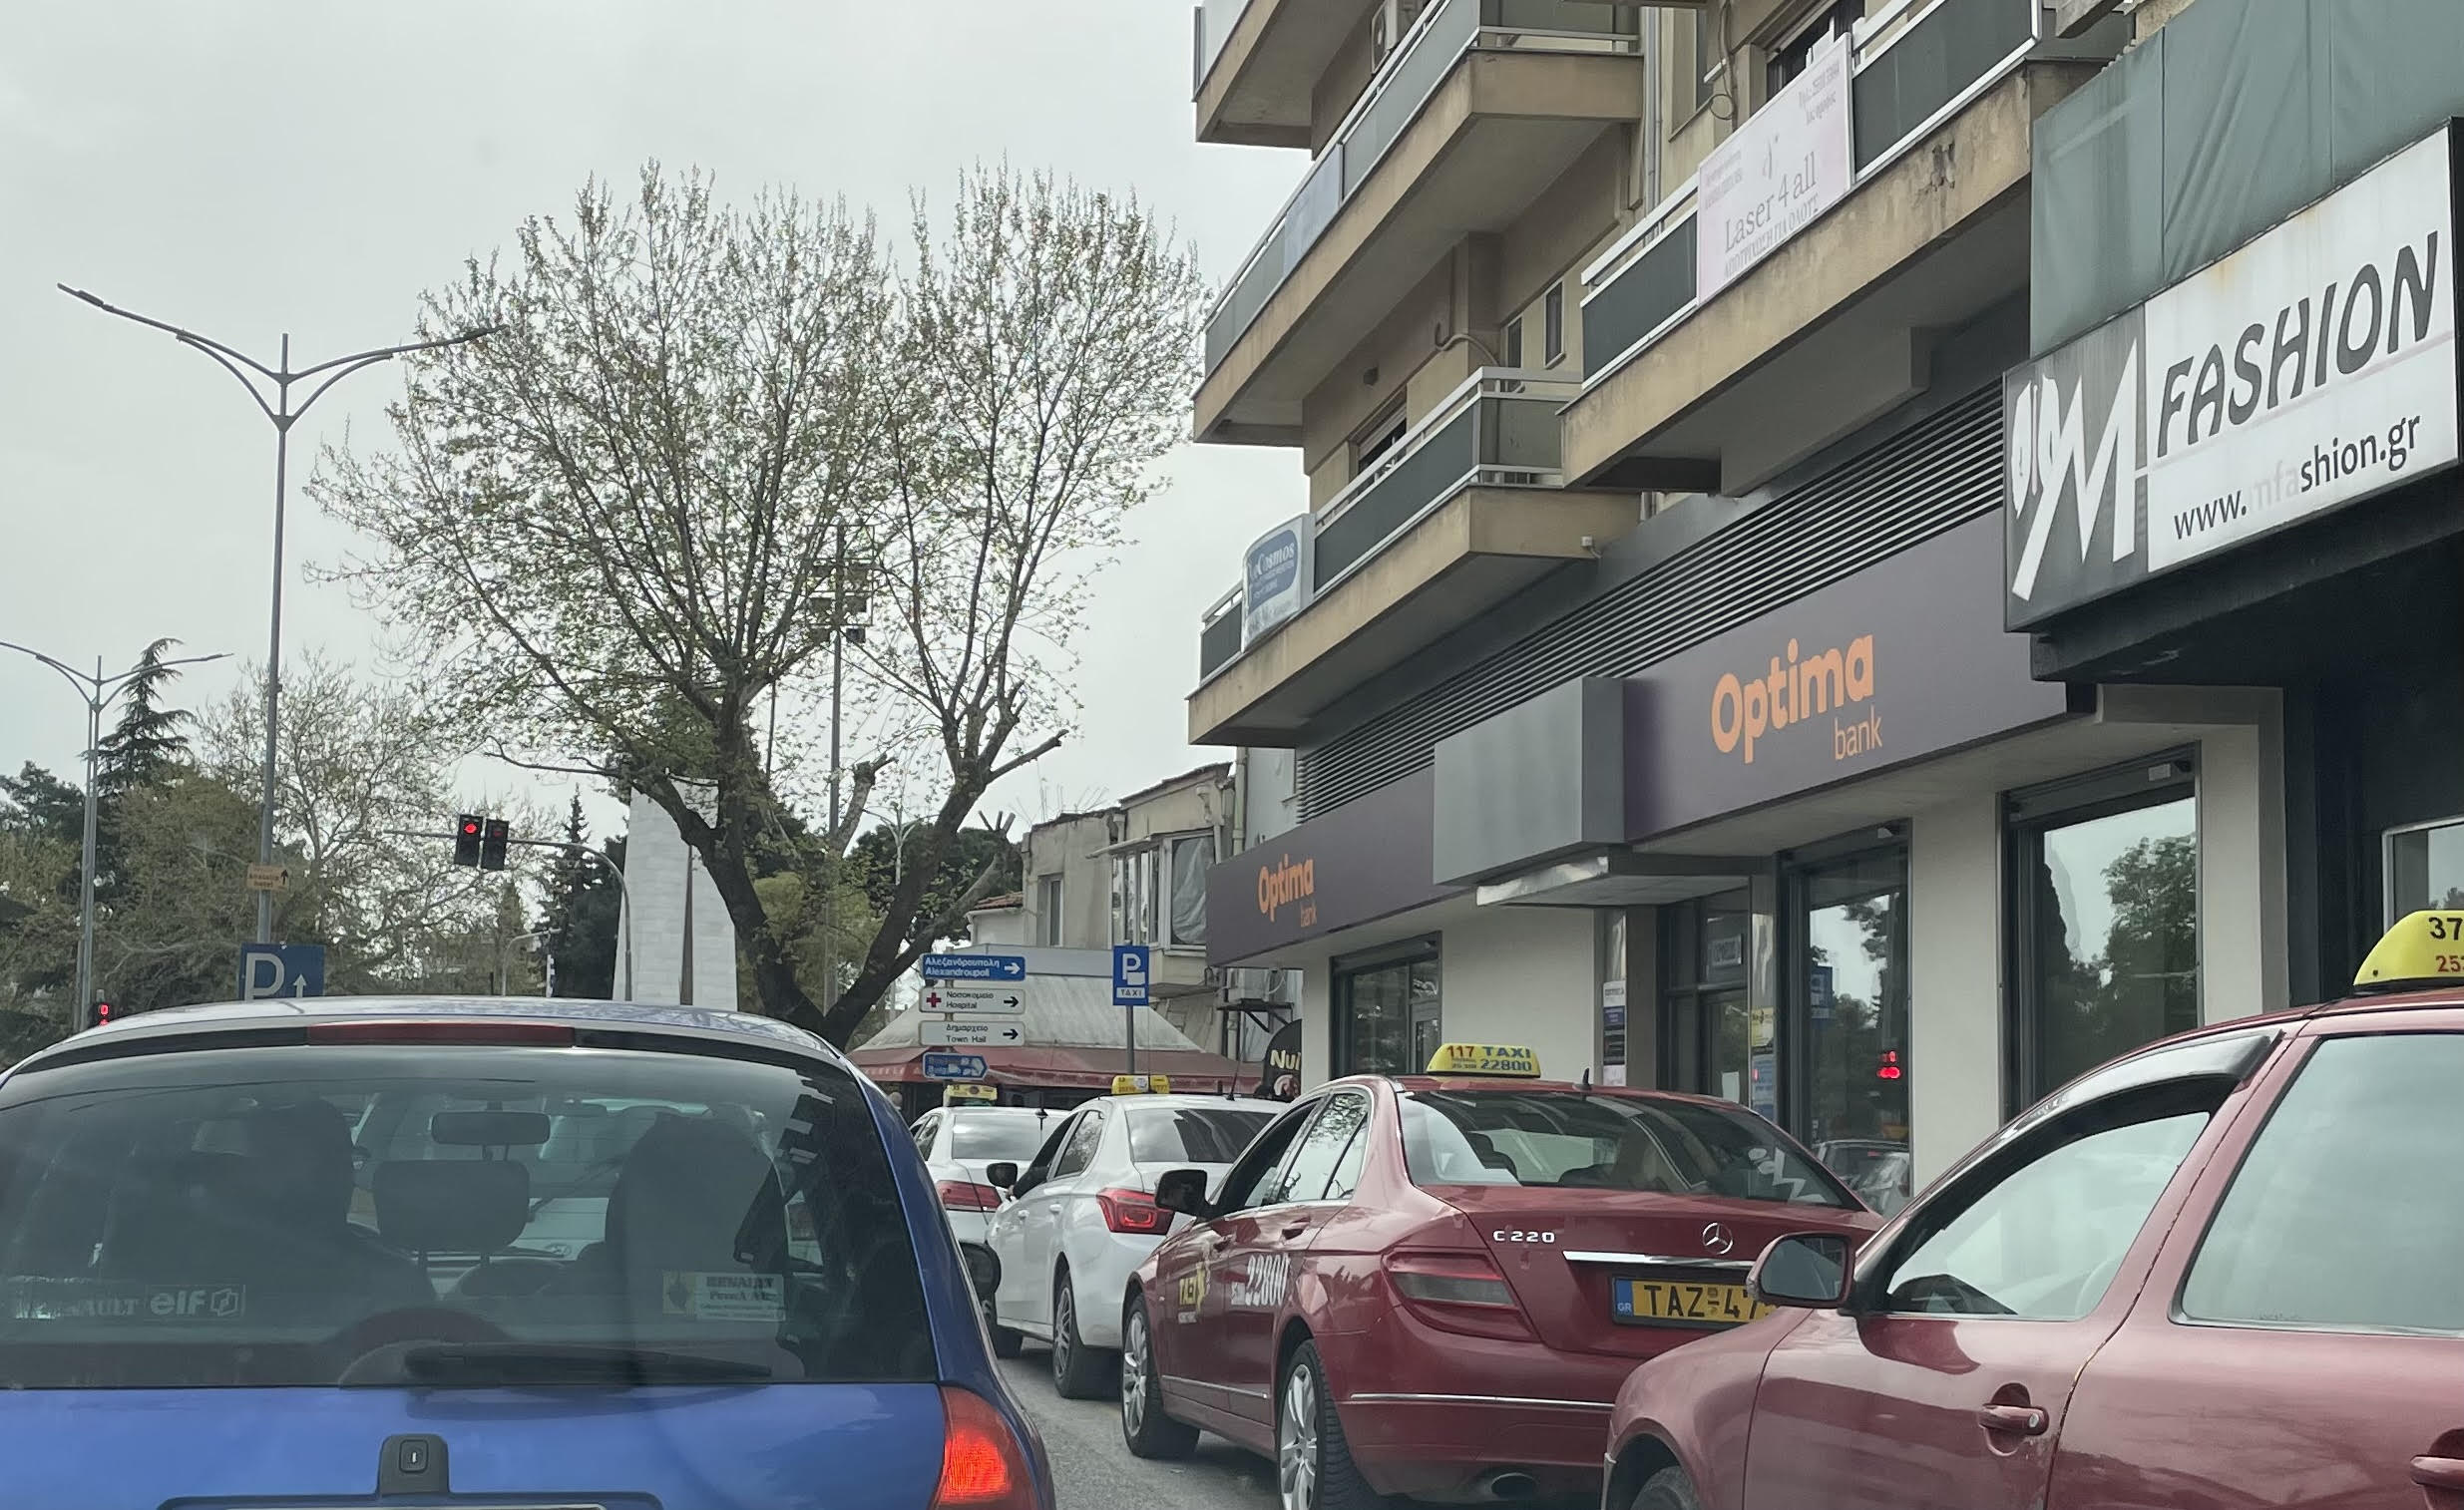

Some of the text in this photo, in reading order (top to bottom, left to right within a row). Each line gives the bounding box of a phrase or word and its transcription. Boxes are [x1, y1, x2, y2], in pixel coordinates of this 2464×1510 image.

[1725, 193, 1775, 253] Laser
[1778, 173, 1790, 207] 4
[1793, 151, 1818, 200] all
[2157, 230, 2438, 459] FASHION
[1711, 633, 1873, 764] Optima
[1835, 704, 1883, 761] bank
[1259, 853, 1314, 924] Optima
[1300, 901, 1318, 928] bank
[2428, 916, 2463, 941] 37
[243, 951, 286, 1002] P
[925, 966, 991, 977] Alexandroupoli
[1122, 952, 1141, 980] P
[2435, 954, 2464, 972] 25
[1446, 1045, 1531, 1058] 117 TAXI
[1480, 1058, 1532, 1072] 22800
[1492, 1230, 1555, 1243] C 220
[1246, 1252, 1290, 1307] 22800
[151, 1290, 205, 1317] elf
[1617, 1302, 1632, 1313] GR
